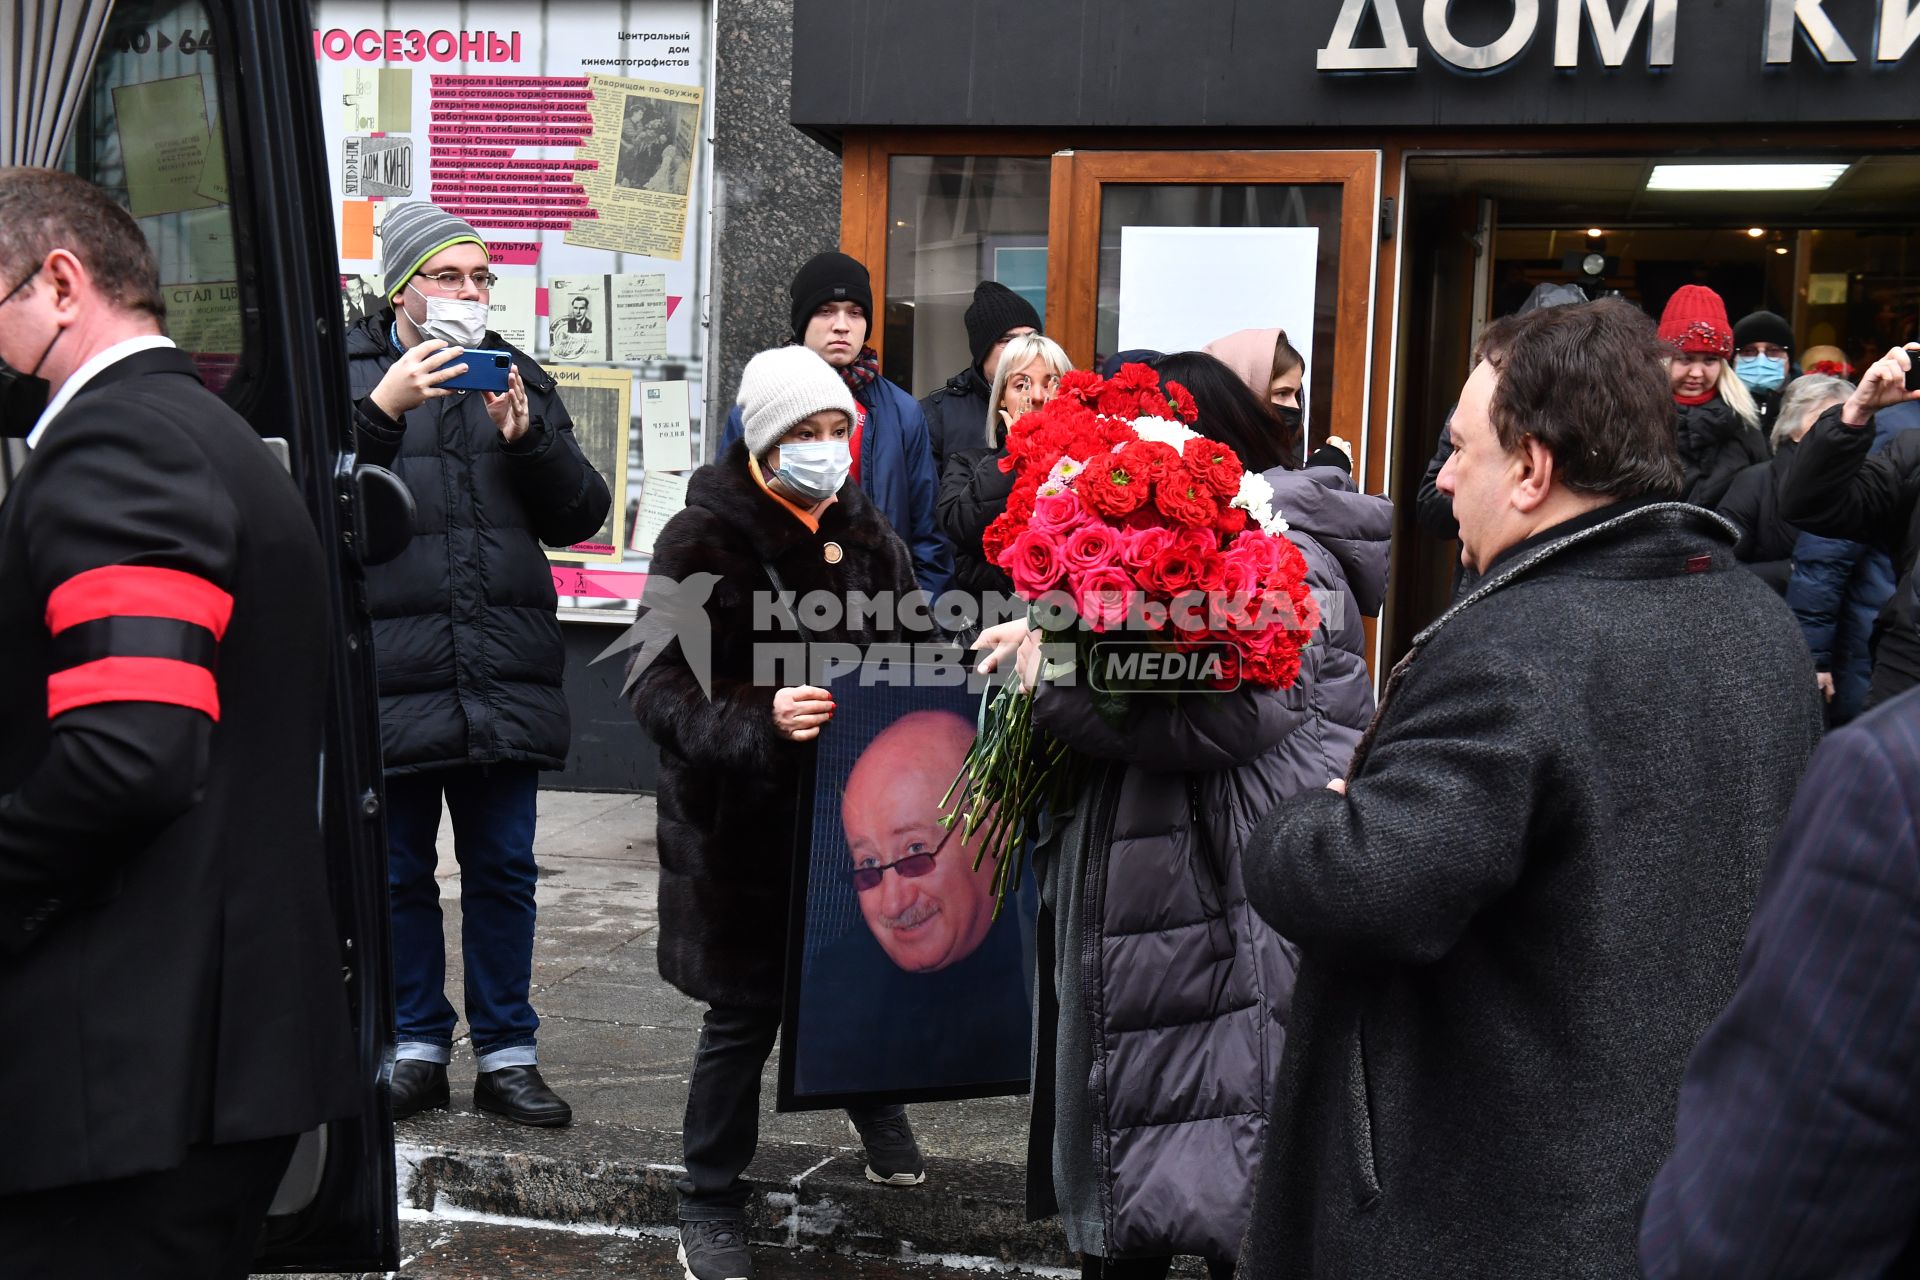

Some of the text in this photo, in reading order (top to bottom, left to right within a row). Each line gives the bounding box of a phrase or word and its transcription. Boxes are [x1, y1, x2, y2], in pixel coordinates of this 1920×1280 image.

[617, 31, 690, 42] Центральный
[668, 46, 690, 54] дом
[581, 57, 690, 68] кинематографистов
[444, 77, 486, 86] февраля
[495, 78, 561, 87] Центральном
[593, 75, 645, 92] Товарищам
[663, 87, 700, 99] оружию
[458, 90, 515, 98] состоялось
[517, 91, 593, 99] торжественное
[433, 102, 586, 111] открытие мемориальной доски
[433, 113, 592, 123] работникам фронтовых съемоч-
[453, 126, 484, 134] групп,
[485, 125, 534, 134] погибшим
[549, 127, 592, 135] времена
[433, 136, 582, 146] Великой Отечественной войны
[433, 148, 449, 156] 1941
[459, 148, 478, 156] 1945
[480, 149, 510, 158] годов.
[362, 152, 379, 181] ДОМ
[383, 145, 411, 189] КИНО
[433, 159, 598, 171] Кинорежиссер Александр Андре-
[432, 171, 468, 179] евский:
[470, 172, 493, 181] «Мы
[544, 174, 572, 182] здесь
[469, 185, 498, 193] перед
[500, 185, 539, 193] светлой
[465, 196, 521, 205] товарищей,
[491, 208, 532, 217] эпизоды
[534, 209, 596, 217] героической
[526, 220, 569, 229] народа»
[490, 242, 539, 252] КУЛЬТУРА,
[489, 254, 504, 262] 959
[173, 286, 239, 303] СТАЛ ЦВ
[545, 371, 580, 381] РАФИИ
